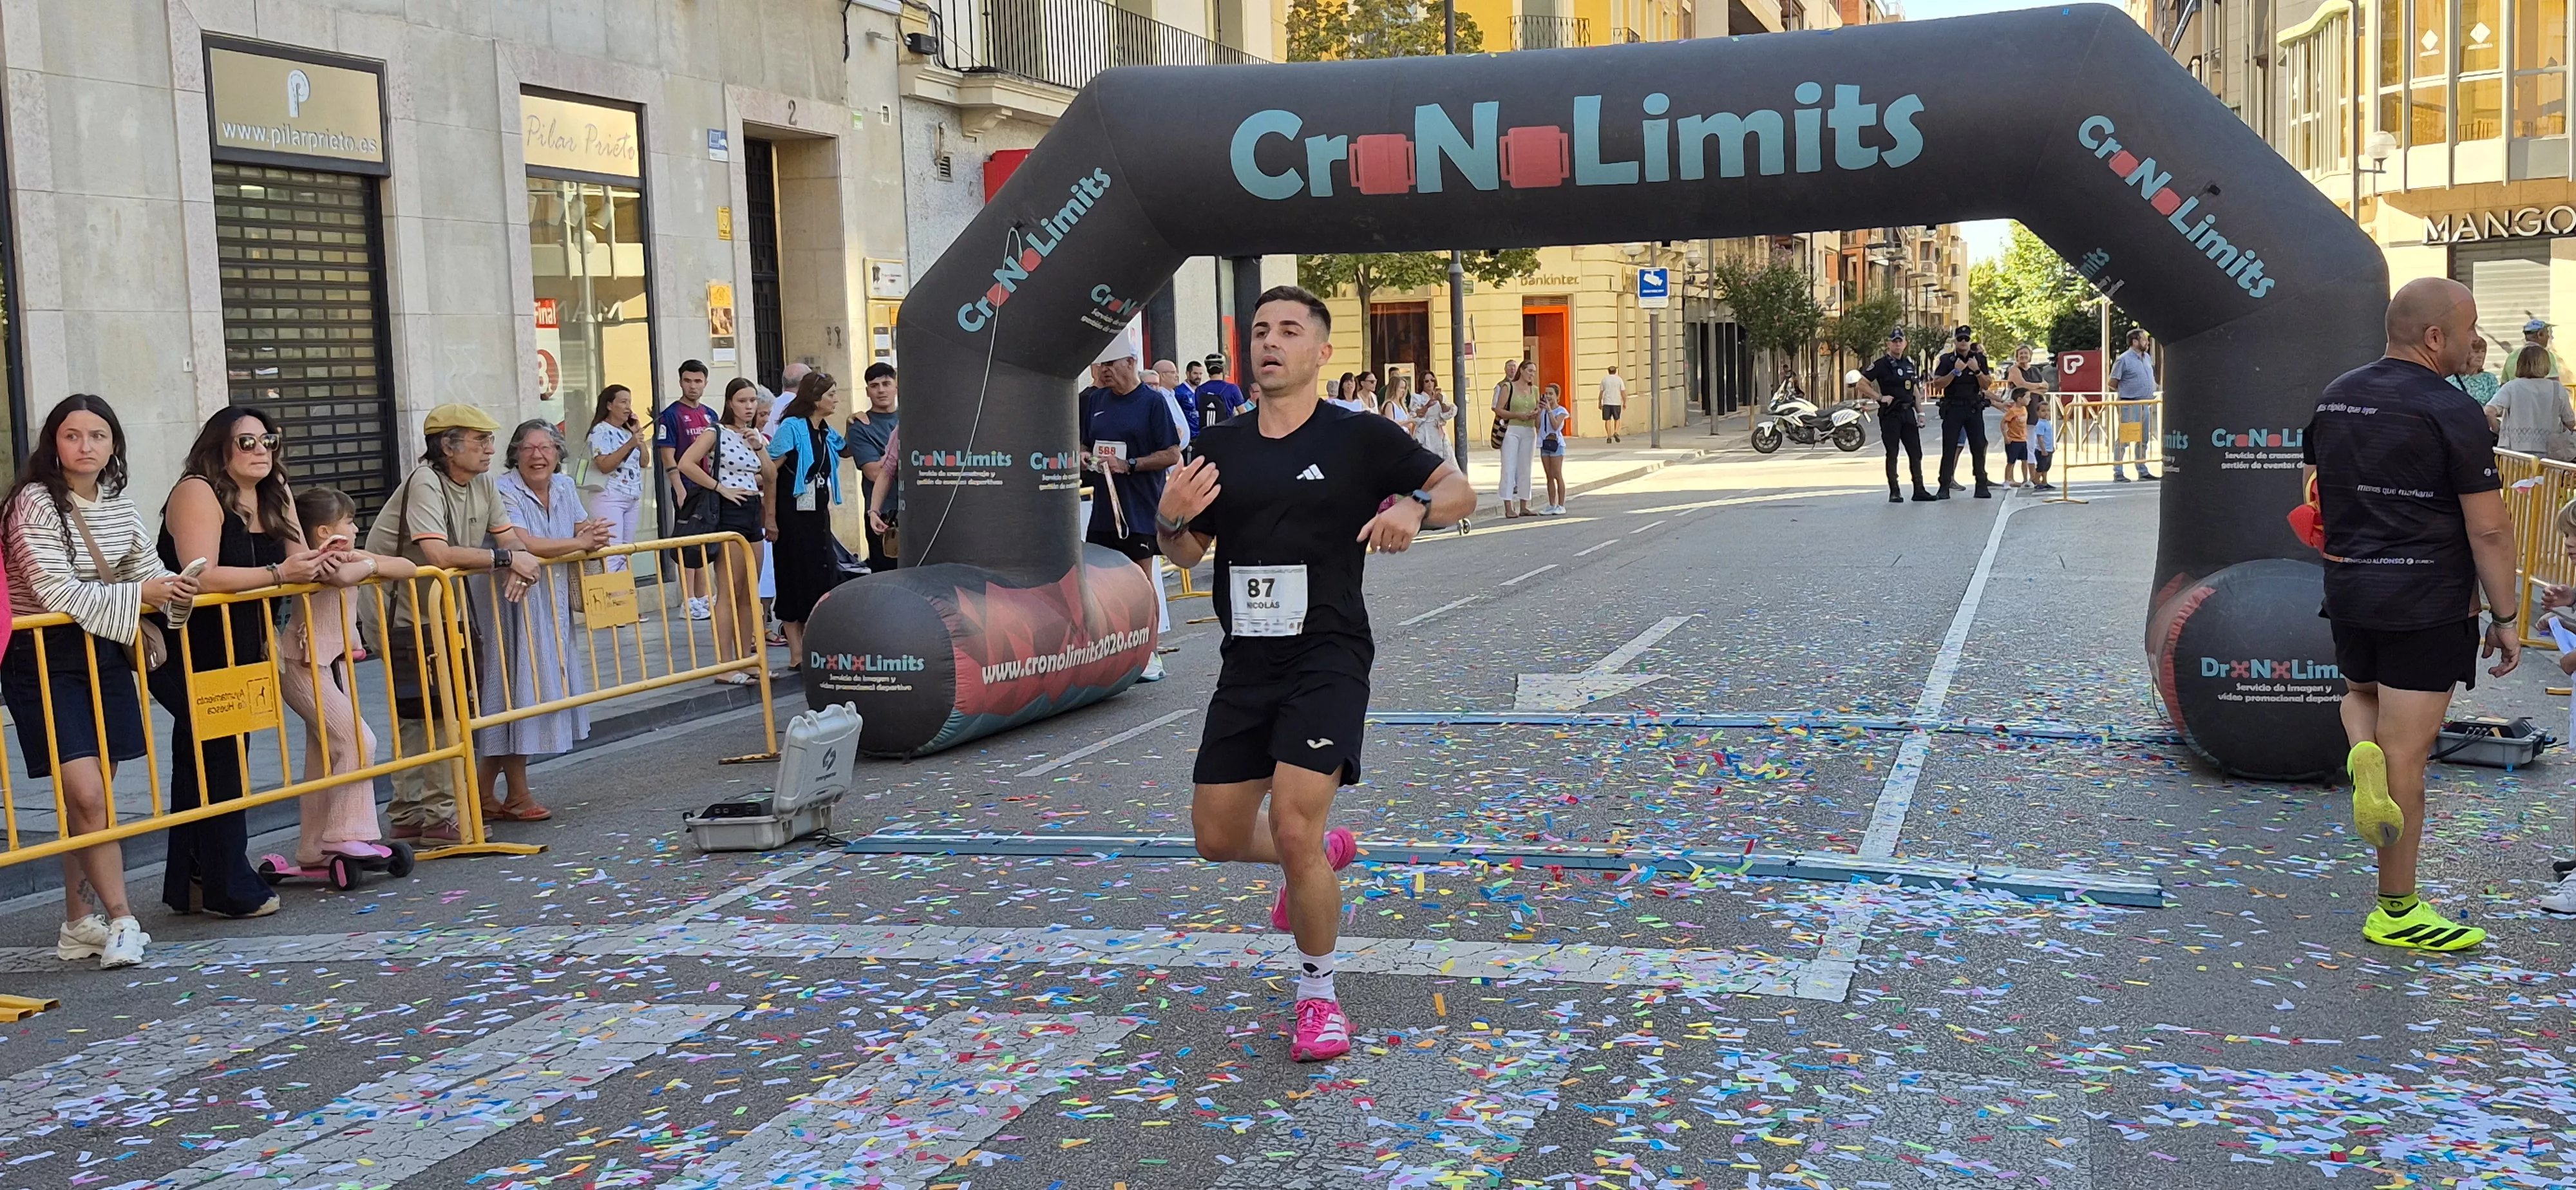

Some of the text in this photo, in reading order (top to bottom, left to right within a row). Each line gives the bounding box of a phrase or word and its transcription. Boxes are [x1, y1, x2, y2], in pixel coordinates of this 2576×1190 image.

[788, 100, 798, 126] 2
[222, 121, 377, 154] www.pilarprieto.es
[527, 115, 635, 160] Pilar Prieto
[2422, 205, 2576, 244] MANGO
[1247, 578, 1275, 598] 87
[1247, 600, 1280, 609] NICOLÁS
[981, 626, 1150, 685] www.cronolimits2020.com
